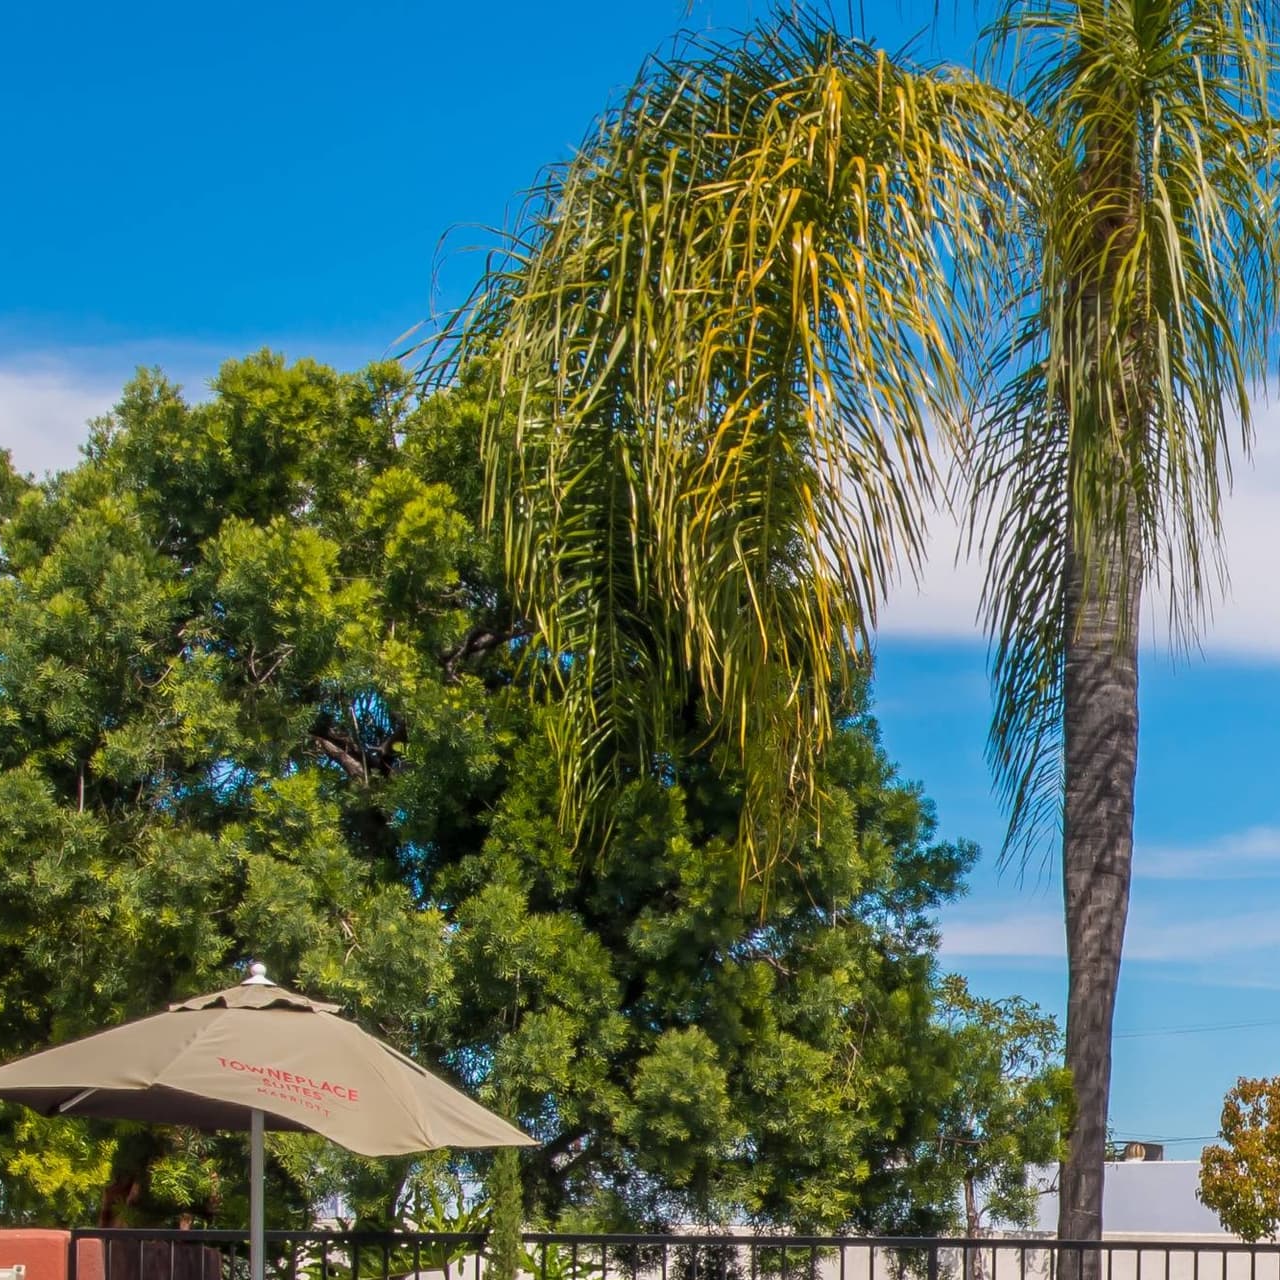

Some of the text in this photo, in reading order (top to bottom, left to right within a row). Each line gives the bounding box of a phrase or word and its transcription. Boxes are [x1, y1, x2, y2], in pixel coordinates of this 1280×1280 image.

[217, 1057, 359, 1101] TOWNEPLACE
[262, 1078, 323, 1100] SUITES
[257, 1088, 331, 1117] MARRIOTT
